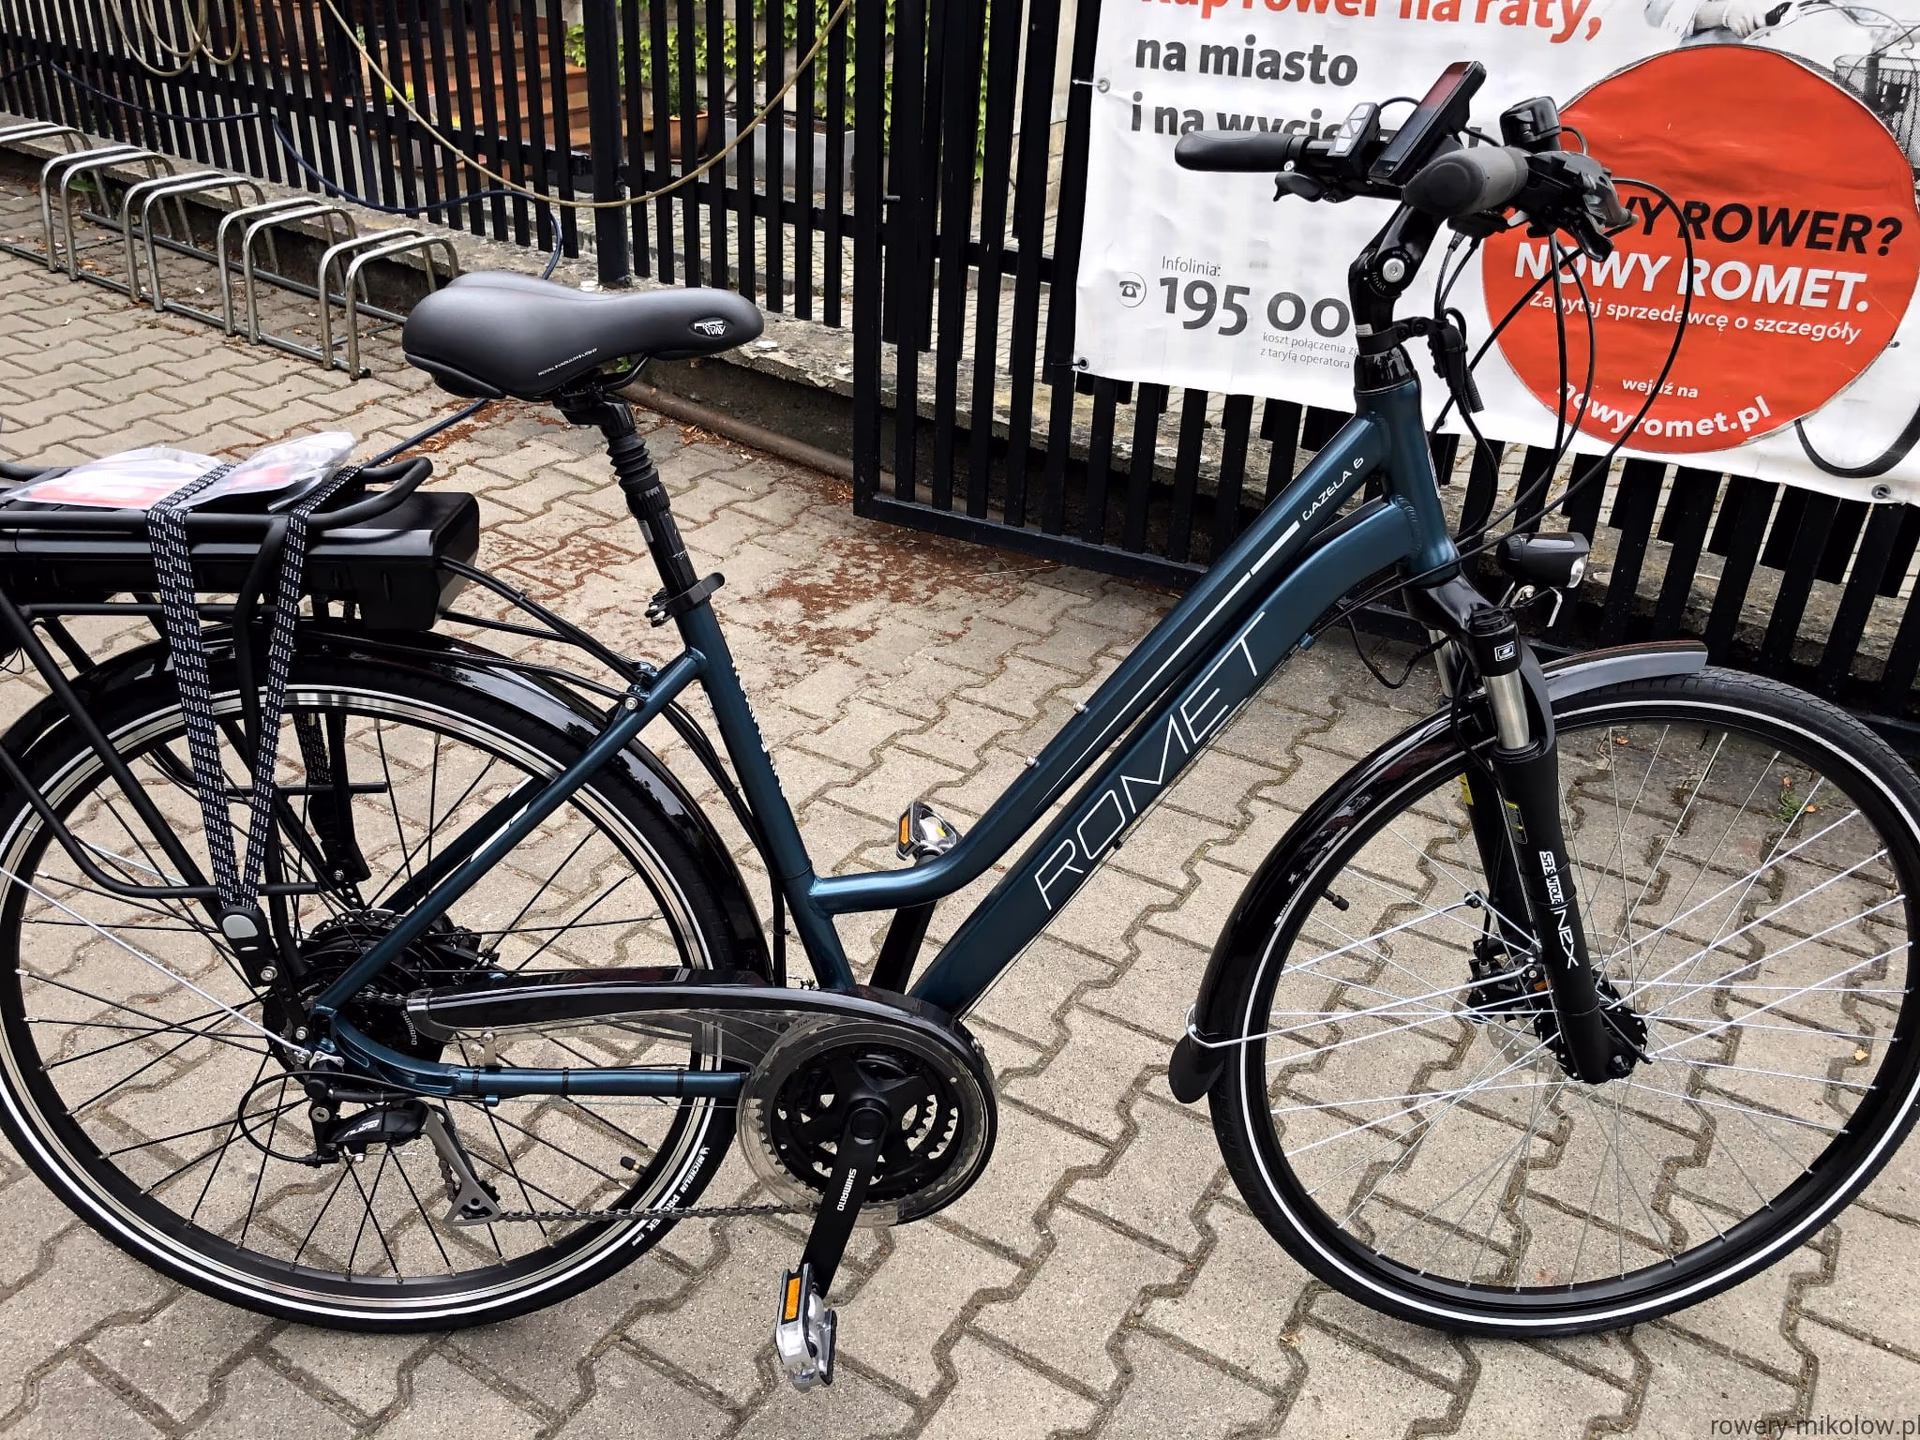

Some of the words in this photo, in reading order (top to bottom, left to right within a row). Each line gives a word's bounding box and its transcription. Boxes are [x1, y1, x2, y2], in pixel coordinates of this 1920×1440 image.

[1399, 0, 1460, 22] na
[1474, 0, 1602, 44] raty,
[1135, 38, 1187, 72] na
[1199, 33, 1358, 87] miasto
[1131, 91, 1143, 131] i
[1154, 106, 1204, 136] na
[1677, 200, 1903, 257] ROWER?
[1161, 255, 1222, 277] Infolinia:
[1514, 242, 1672, 292] NOWY
[1677, 258, 1870, 313] ROMET.
[1159, 276, 1251, 337] 195
[1606, 303, 1728, 332] sprzedawcę
[1734, 317, 1748, 329] o
[1753, 318, 1861, 345] szczegóły
[1262, 331, 1289, 345] koszt
[1291, 338, 1346, 354] połączenia
[1268, 348, 1298, 363] taryfą
[1299, 354, 1350, 369] operatora
[1556, 381, 1771, 437] nowyromet.pl
[1677, 386, 1699, 399] na
[1353, 457, 1364, 470] 6
[1035, 611, 1265, 910] ROMET
[1544, 868, 1564, 905] SNTOUR
[400, 1009, 418, 1046] SHIMANO
[836, 1167, 857, 1212] SHIMANO
[646, 1193, 681, 1232] PREK
